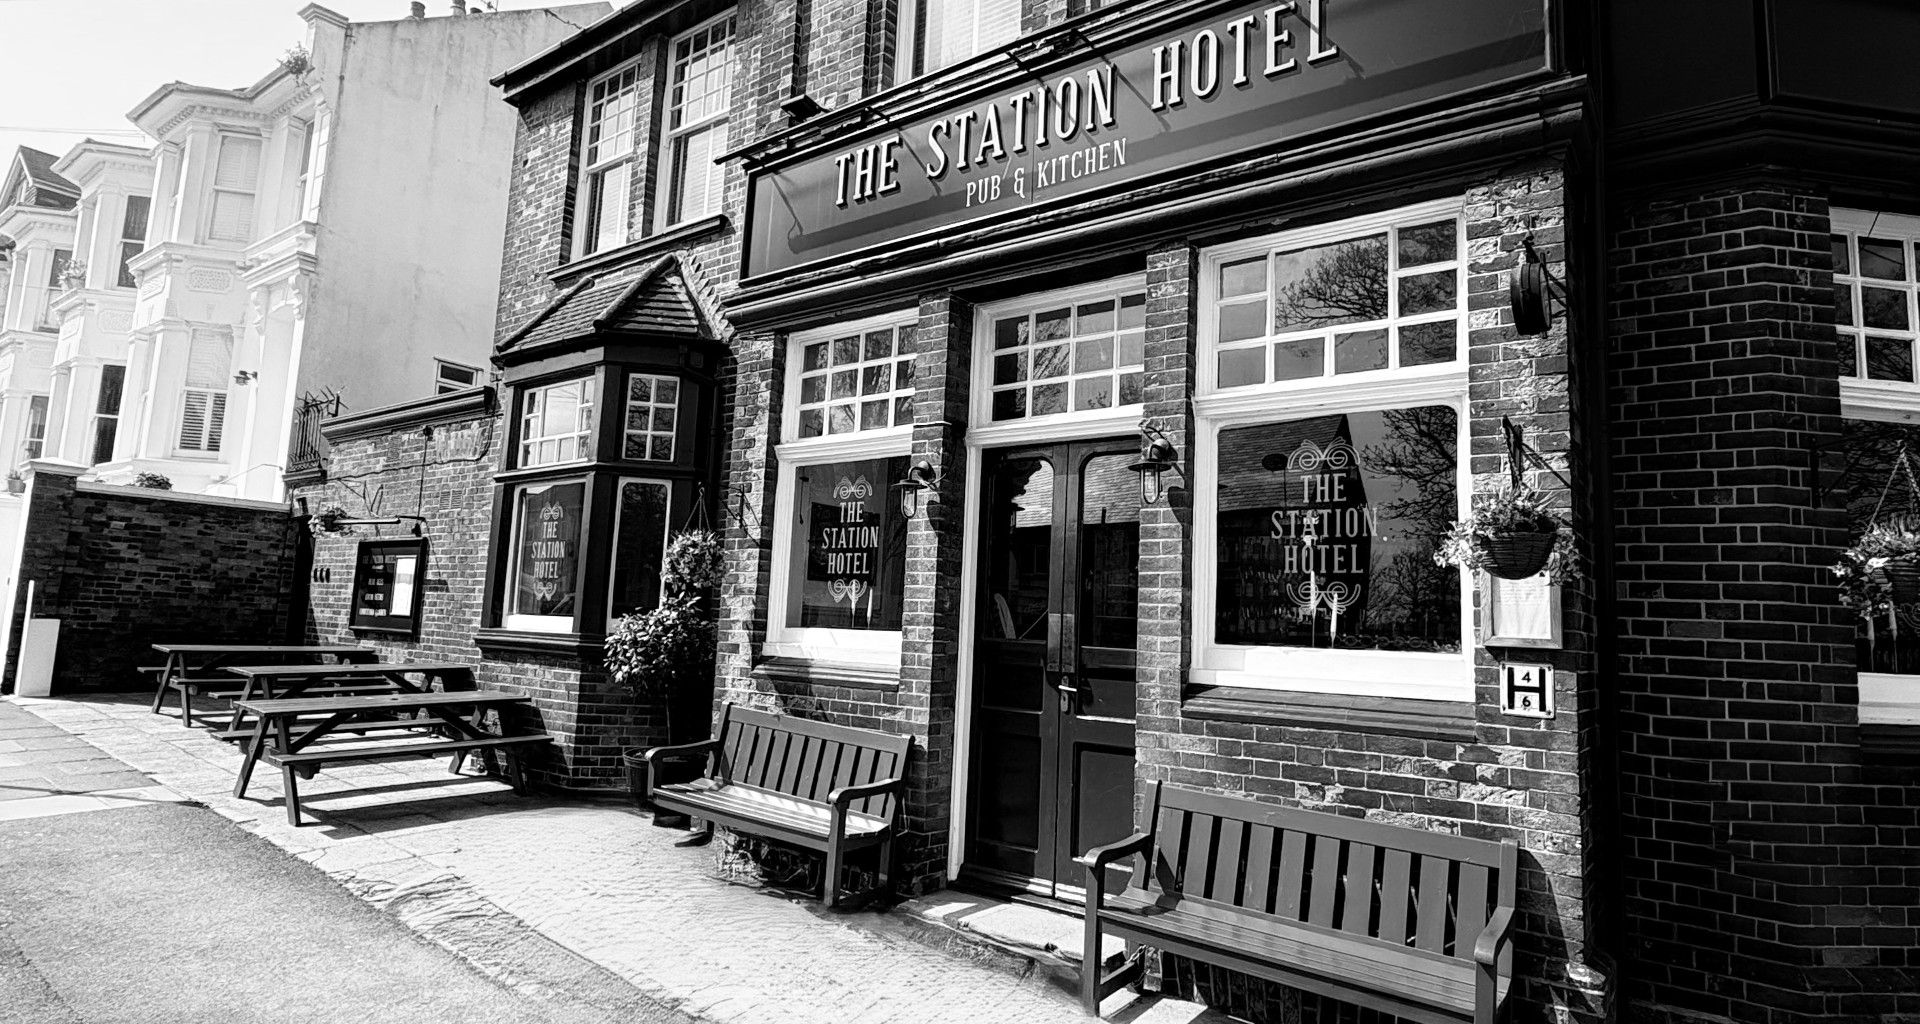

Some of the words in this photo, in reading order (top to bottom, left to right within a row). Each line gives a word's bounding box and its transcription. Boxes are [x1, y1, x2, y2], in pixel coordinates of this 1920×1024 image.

[834, 135, 901, 208] THE
[926, 62, 1116, 180] STATION
[1151, 0, 1339, 112] HOTEL
[966, 170, 1001, 208] PUB
[1013, 167, 1026, 199] &
[1036, 137, 1127, 189] KITCHEN
[1301, 473, 1347, 503] THE
[839, 501, 865, 523] THE
[1271, 507, 1378, 539] STATION
[542, 521, 559, 539] THE
[821, 526, 879, 549] STATION
[531, 541, 566, 559] STATION
[1284, 544, 1363, 574] HOTEL
[533, 561, 559, 579] HOTEL
[827, 552, 870, 574] HOTEL
[1521, 672, 1531, 683] 4
[1507, 667, 1546, 712] H
[1522, 696, 1531, 707] 6
